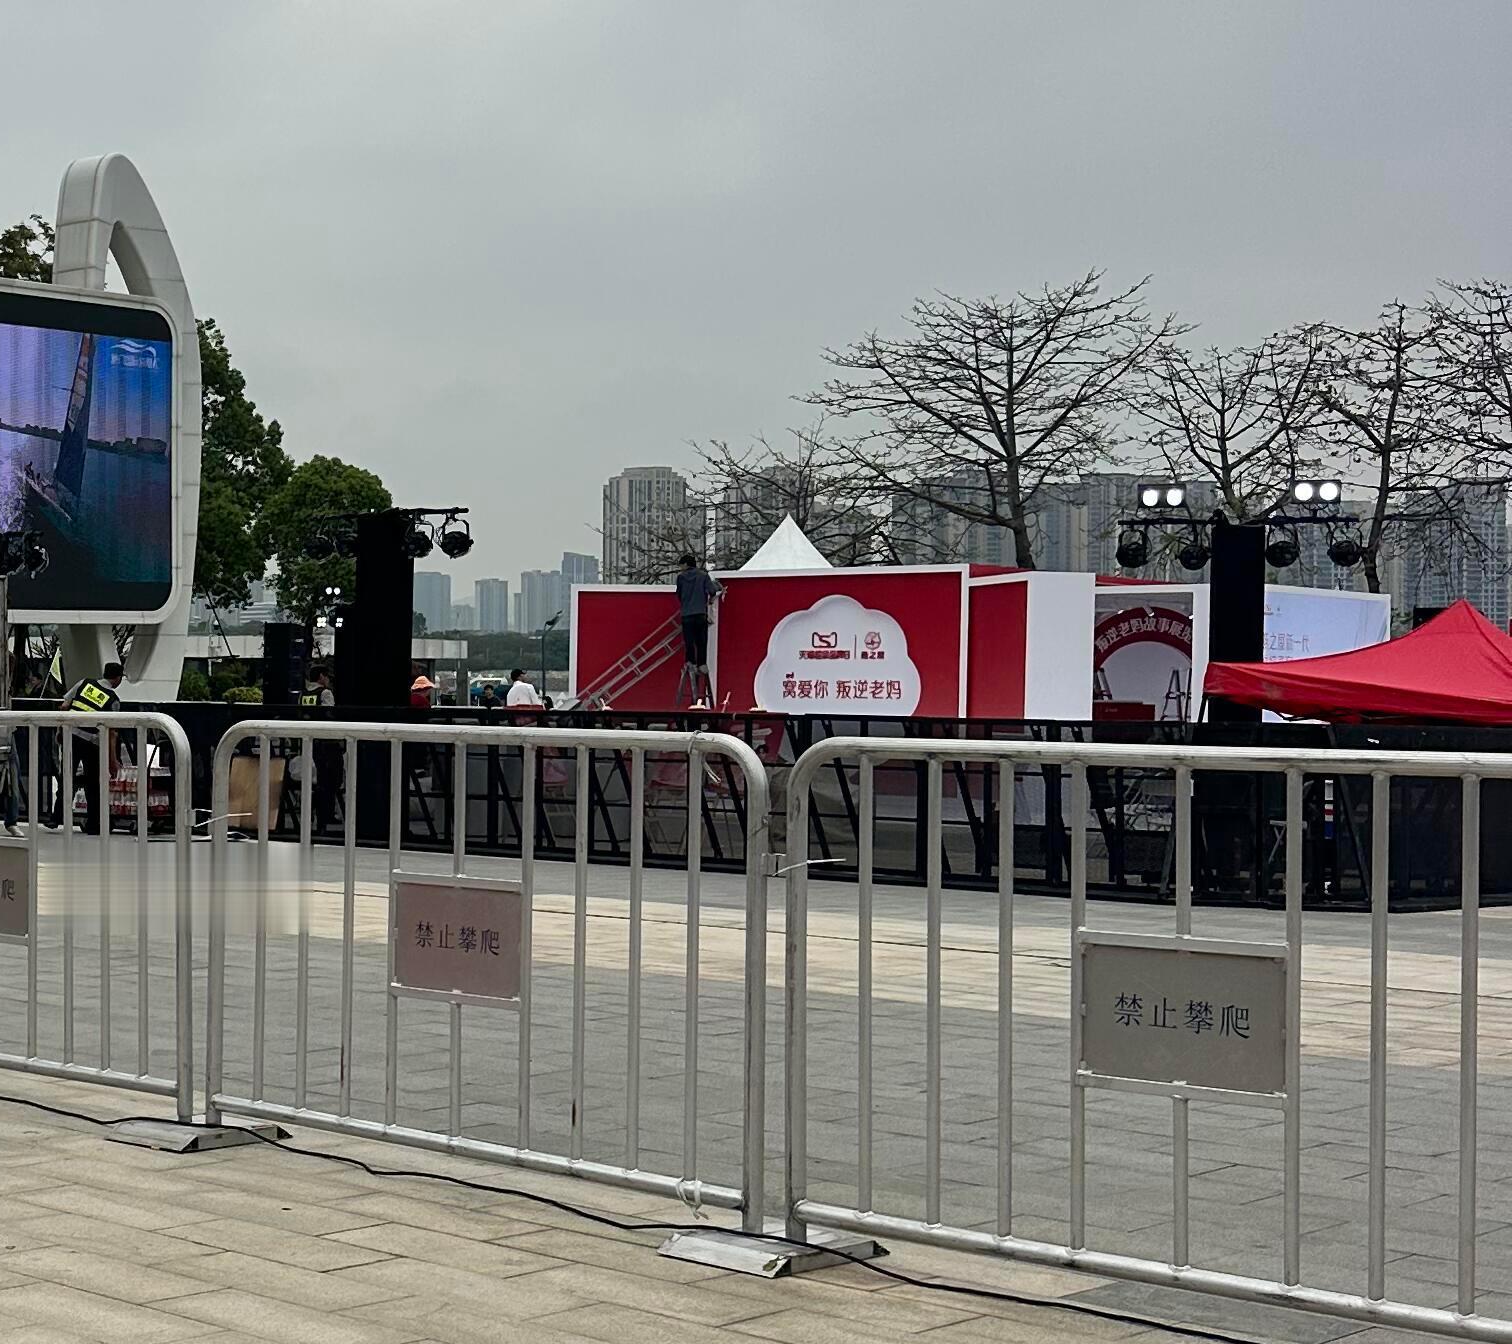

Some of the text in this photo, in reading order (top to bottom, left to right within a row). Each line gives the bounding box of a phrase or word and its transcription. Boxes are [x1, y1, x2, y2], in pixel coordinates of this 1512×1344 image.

[782, 679, 902, 699] 窝爱你 叛逆老妈
[415, 920, 500, 956] 禁止攀爬
[1113, 991, 1250, 1039] 禁止攀爬
